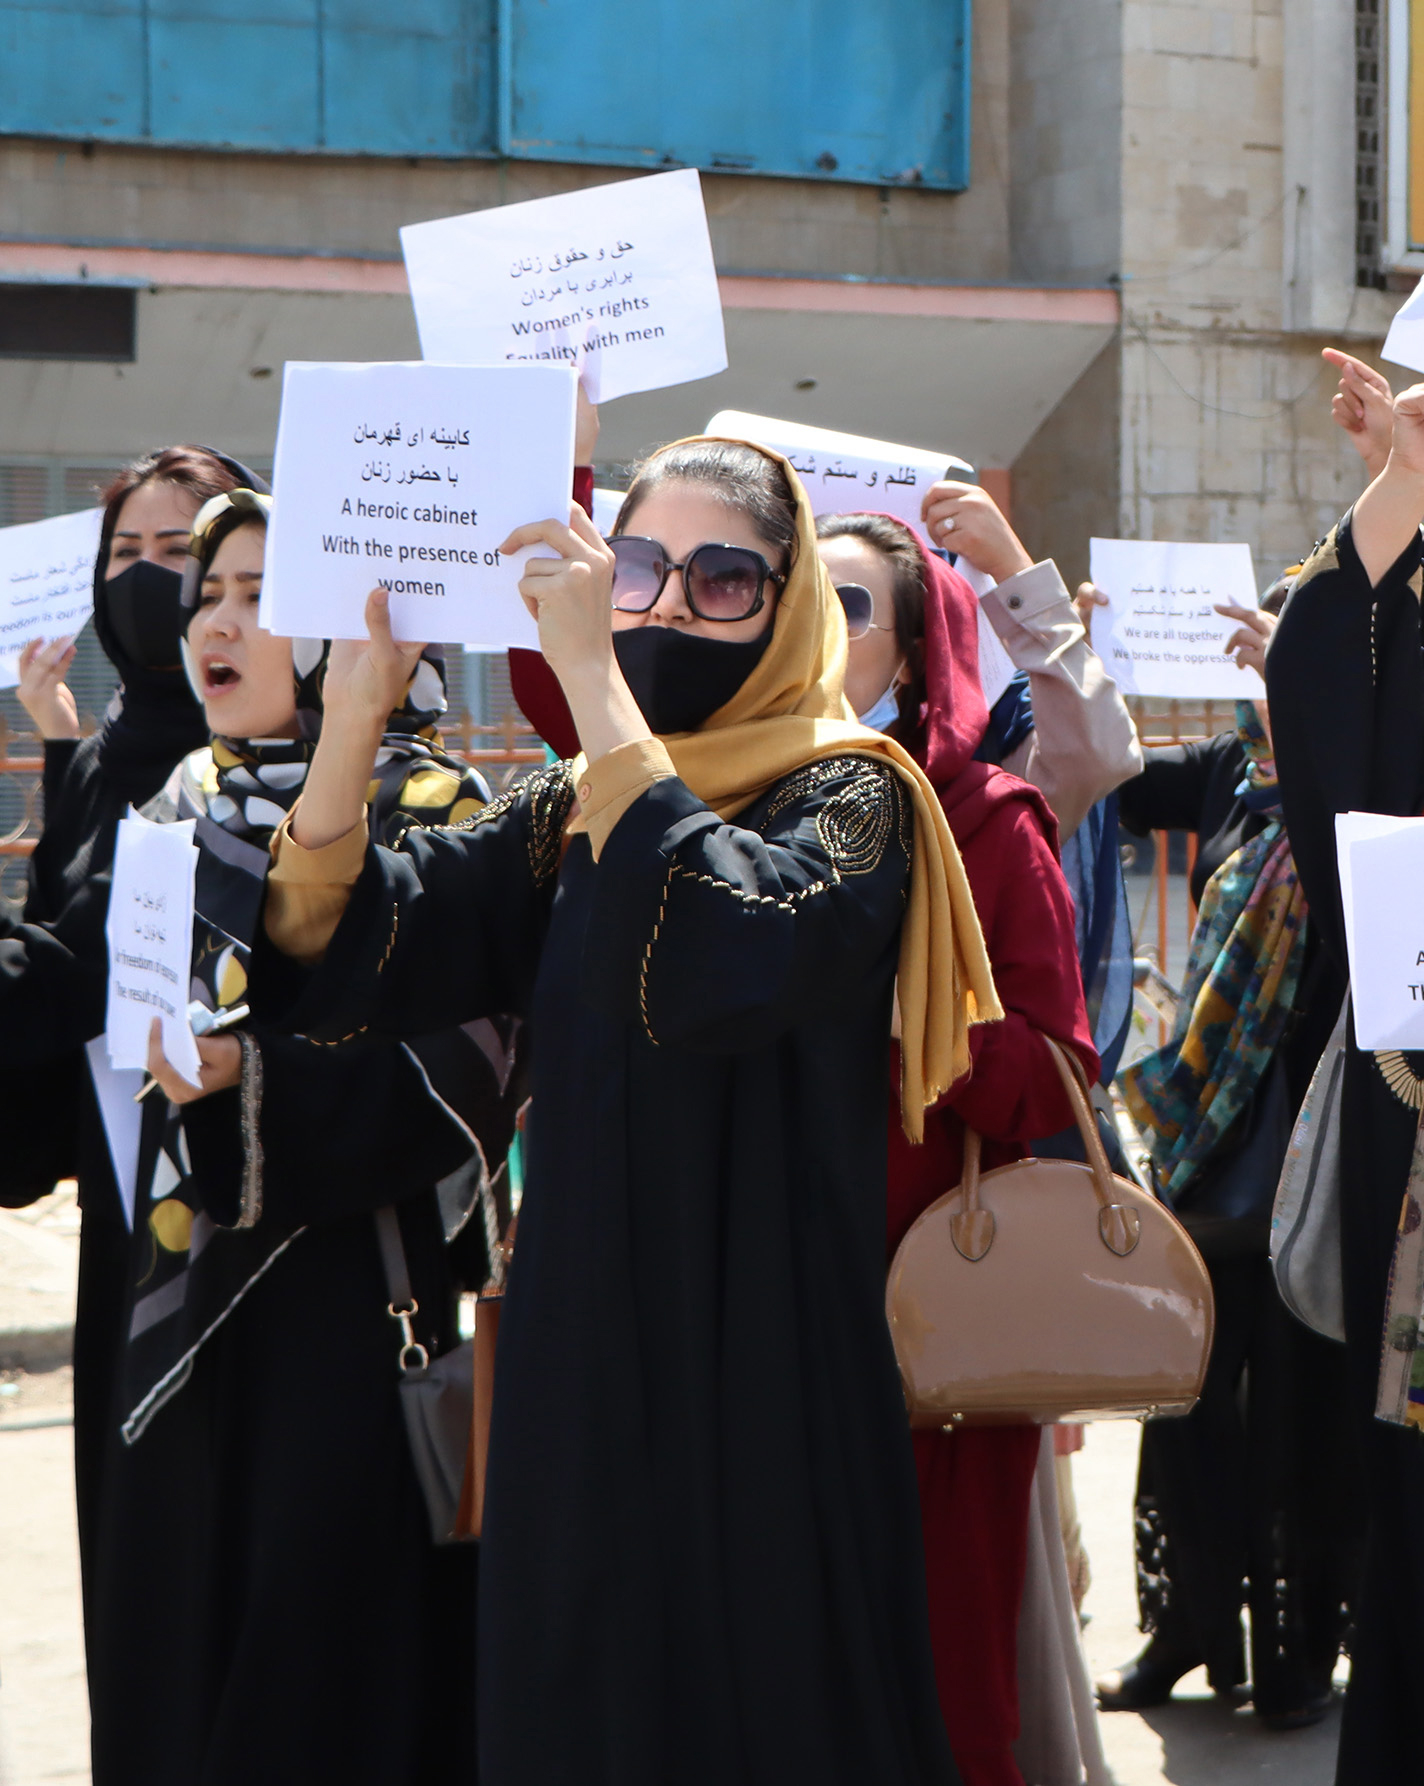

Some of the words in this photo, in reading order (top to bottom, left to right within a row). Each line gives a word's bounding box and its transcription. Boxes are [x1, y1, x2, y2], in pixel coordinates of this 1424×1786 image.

[596, 248, 605, 260] و
[610, 240, 634, 258] حق
[510, 256, 543, 278] زنان
[548, 248, 589, 272] حقوق
[521, 287, 562, 306] مردان
[567, 279, 579, 294] با
[512, 307, 594, 336] Women's
[600, 296, 649, 318] rights
[583, 332, 619, 353] with
[626, 325, 665, 342] men
[354, 421, 400, 447] قهرمان
[407, 427, 423, 447] ای
[430, 427, 470, 449] کابینه
[361, 460, 391, 482] زنان
[396, 464, 441, 484] حضور
[447, 466, 458, 487] با
[823, 461, 858, 484] ستم
[866, 471, 877, 487] و
[884, 467, 916, 492] ظلم
[341, 499, 352, 515] A
[357, 498, 408, 520] heroic
[413, 504, 478, 526] cabinet
[322, 535, 360, 555] With
[365, 539, 393, 557] the
[399, 545, 478, 564] presence
[483, 548, 501, 566] of
[378, 578, 445, 596] women
[1124, 627, 1141, 638] We
[1144, 630, 1159, 639] are
[1163, 628, 1174, 639] all
[1178, 630, 1223, 642] together
[1113, 648, 1129, 659] We
[1132, 649, 1160, 661] broke
[1164, 650, 1180, 662] the
